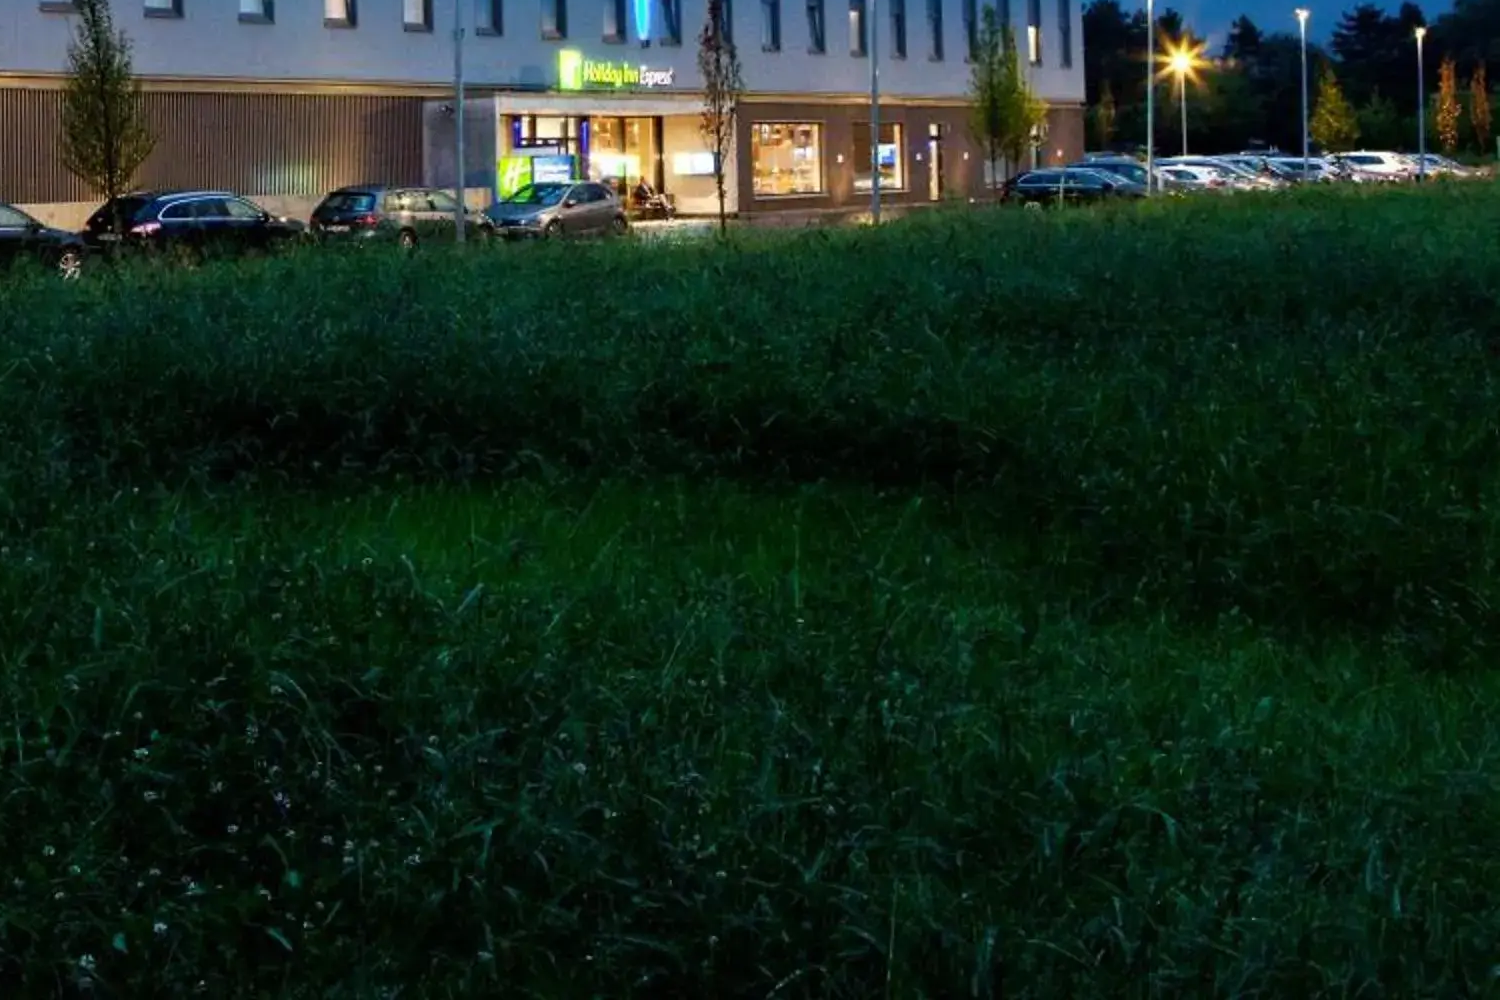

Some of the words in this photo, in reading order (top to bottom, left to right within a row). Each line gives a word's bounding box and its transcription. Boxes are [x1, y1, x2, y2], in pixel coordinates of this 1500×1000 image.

[583, 60, 622, 87] Holiday
[623, 61, 639, 83] Inn
[640, 65, 672, 88] Express
